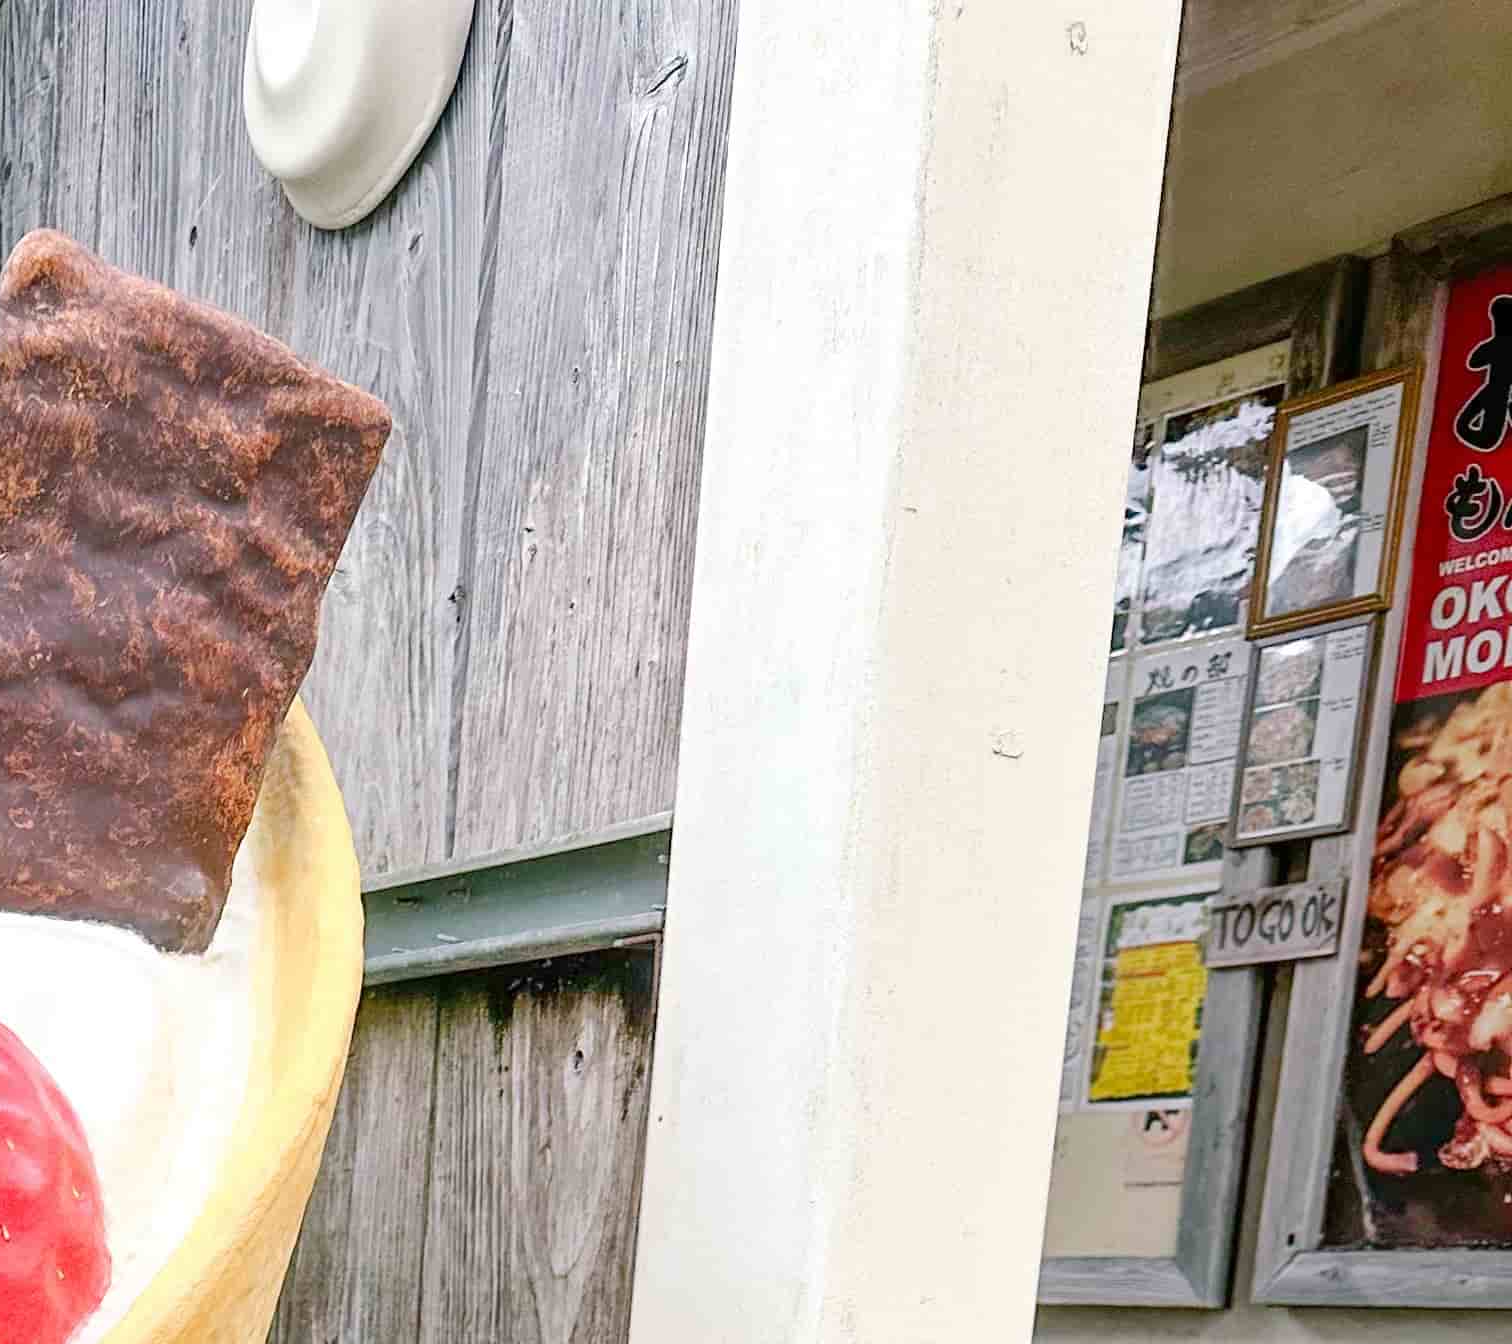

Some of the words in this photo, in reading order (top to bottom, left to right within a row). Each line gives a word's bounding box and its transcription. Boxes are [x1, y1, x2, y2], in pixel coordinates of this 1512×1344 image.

[1444, 463, 1512, 543] も
[1431, 575, 1512, 631] OK
[1422, 623, 1512, 684] MO
